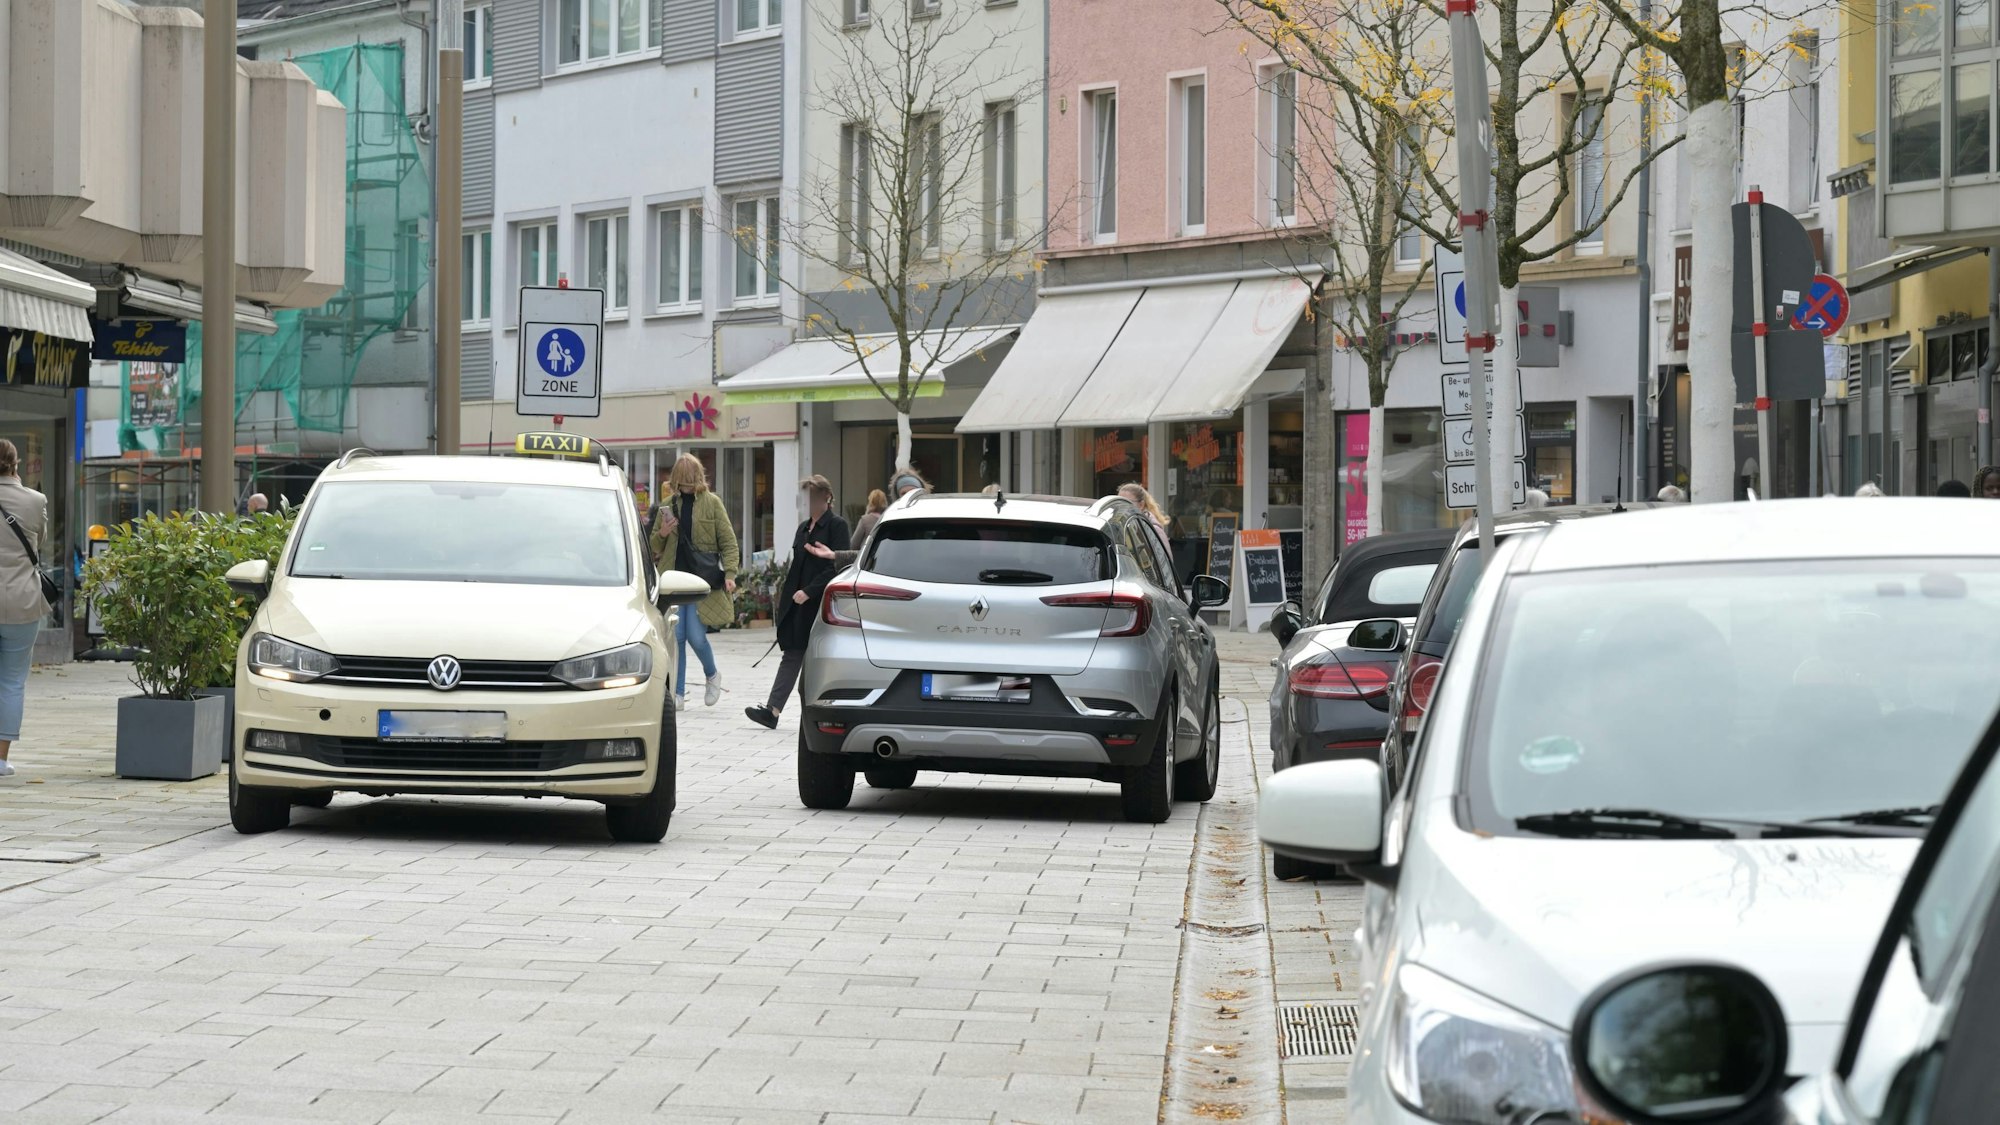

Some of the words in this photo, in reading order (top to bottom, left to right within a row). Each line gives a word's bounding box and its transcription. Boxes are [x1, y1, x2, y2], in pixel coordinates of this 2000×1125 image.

[112, 340, 169, 357] Tchibo
[541, 379, 578, 393] ZONE
[530, 435, 577, 451] TAXI
[1454, 448, 1464, 458] bis
[1465, 448, 1474, 457] Ba
[937, 625, 1021, 636] CAPTUR
